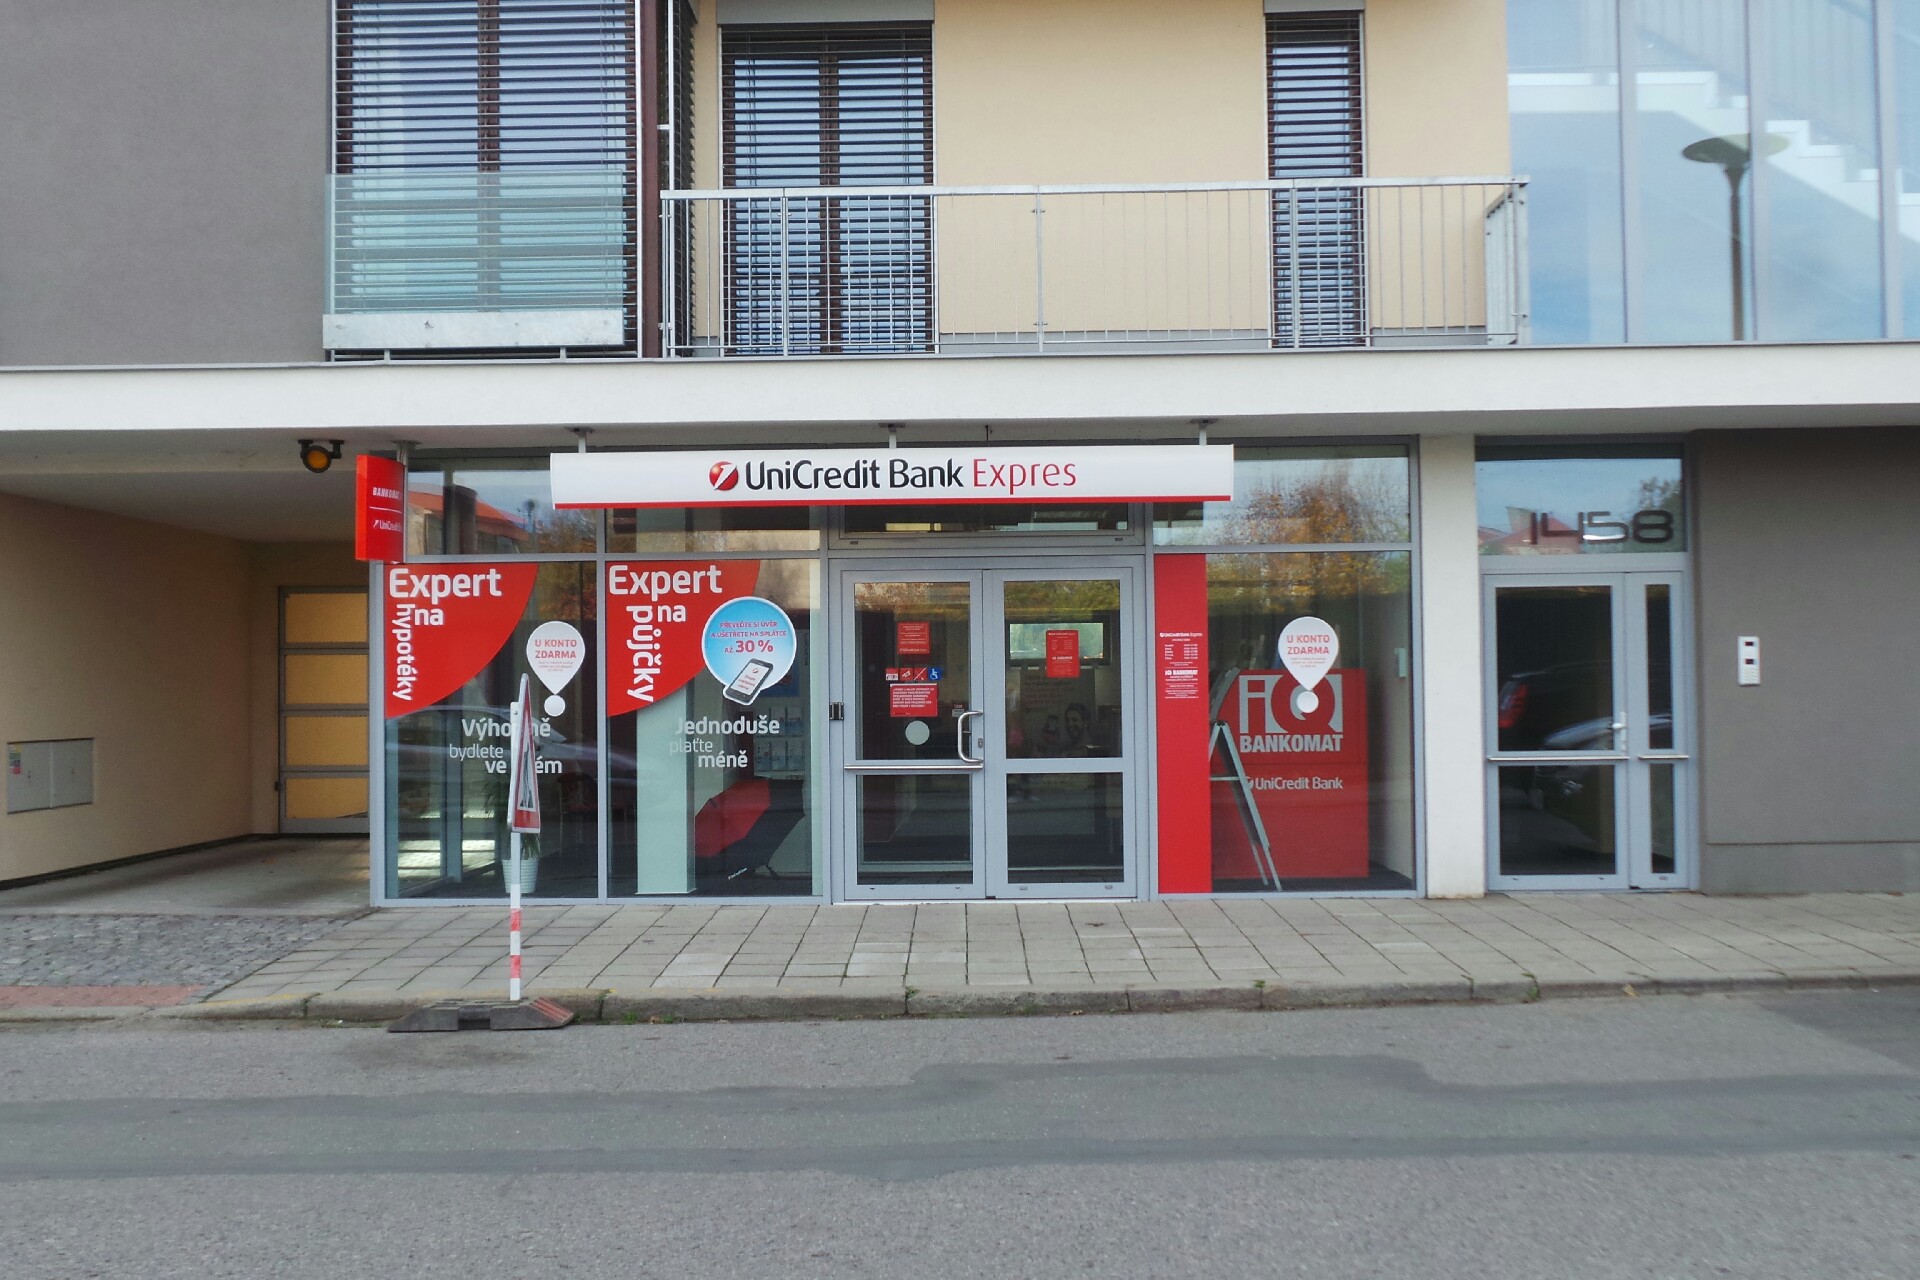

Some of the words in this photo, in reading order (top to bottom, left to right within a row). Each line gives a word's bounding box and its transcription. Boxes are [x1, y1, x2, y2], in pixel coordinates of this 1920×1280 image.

[745, 459, 880, 491] UniCredit
[889, 458, 964, 489] Bank
[973, 457, 1076, 495] Expres
[1530, 509, 1674, 545] 1458
[389, 567, 502, 605] Expert
[609, 564, 723, 602] Expert
[414, 608, 444, 626] na
[657, 604, 687, 623] na
[534, 639, 542, 647] U
[544, 639, 577, 647] KONTO
[735, 639, 755, 653] 30
[757, 639, 774, 653] %
[1286, 634, 1294, 643] U
[1296, 634, 1330, 643] KONTO
[391, 603, 418, 701] hypotéky
[535, 650, 577, 659] ZDARMA
[626, 605, 662, 703] půjčky
[1287, 646, 1330, 655] ZDARMA
[461, 717, 551, 741] Výhoně
[675, 714, 780, 735] Jednoduše
[449, 743, 504, 762] bydlete
[669, 737, 713, 757] plaťte
[1239, 734, 1344, 753] BANKOMAT
[484, 760, 507, 774] ve
[698, 749, 748, 768] méně
[1255, 776, 1310, 790] UniCredit
[1312, 776, 1343, 790] Bank
